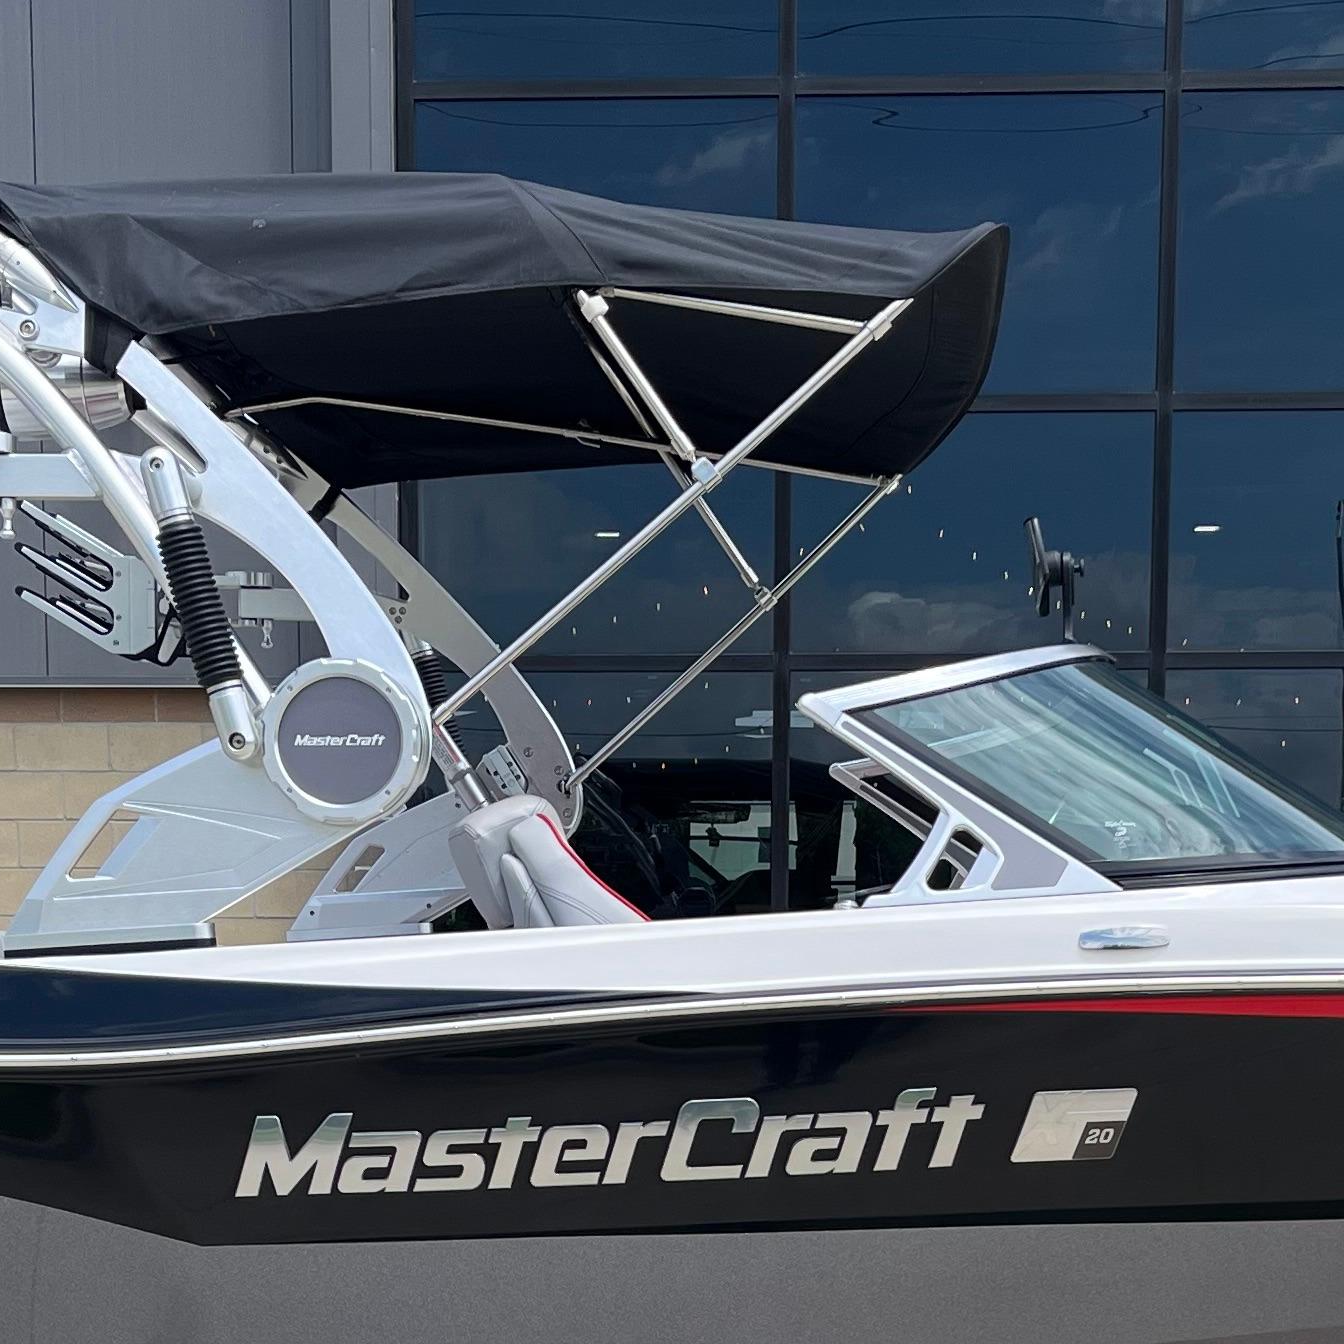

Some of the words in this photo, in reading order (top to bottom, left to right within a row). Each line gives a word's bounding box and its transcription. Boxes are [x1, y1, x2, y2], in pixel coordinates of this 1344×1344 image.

[294, 733, 386, 747] MasterCraft
[234, 1086, 985, 1199] MasterCraft
[1084, 1128, 1116, 1145] 20
